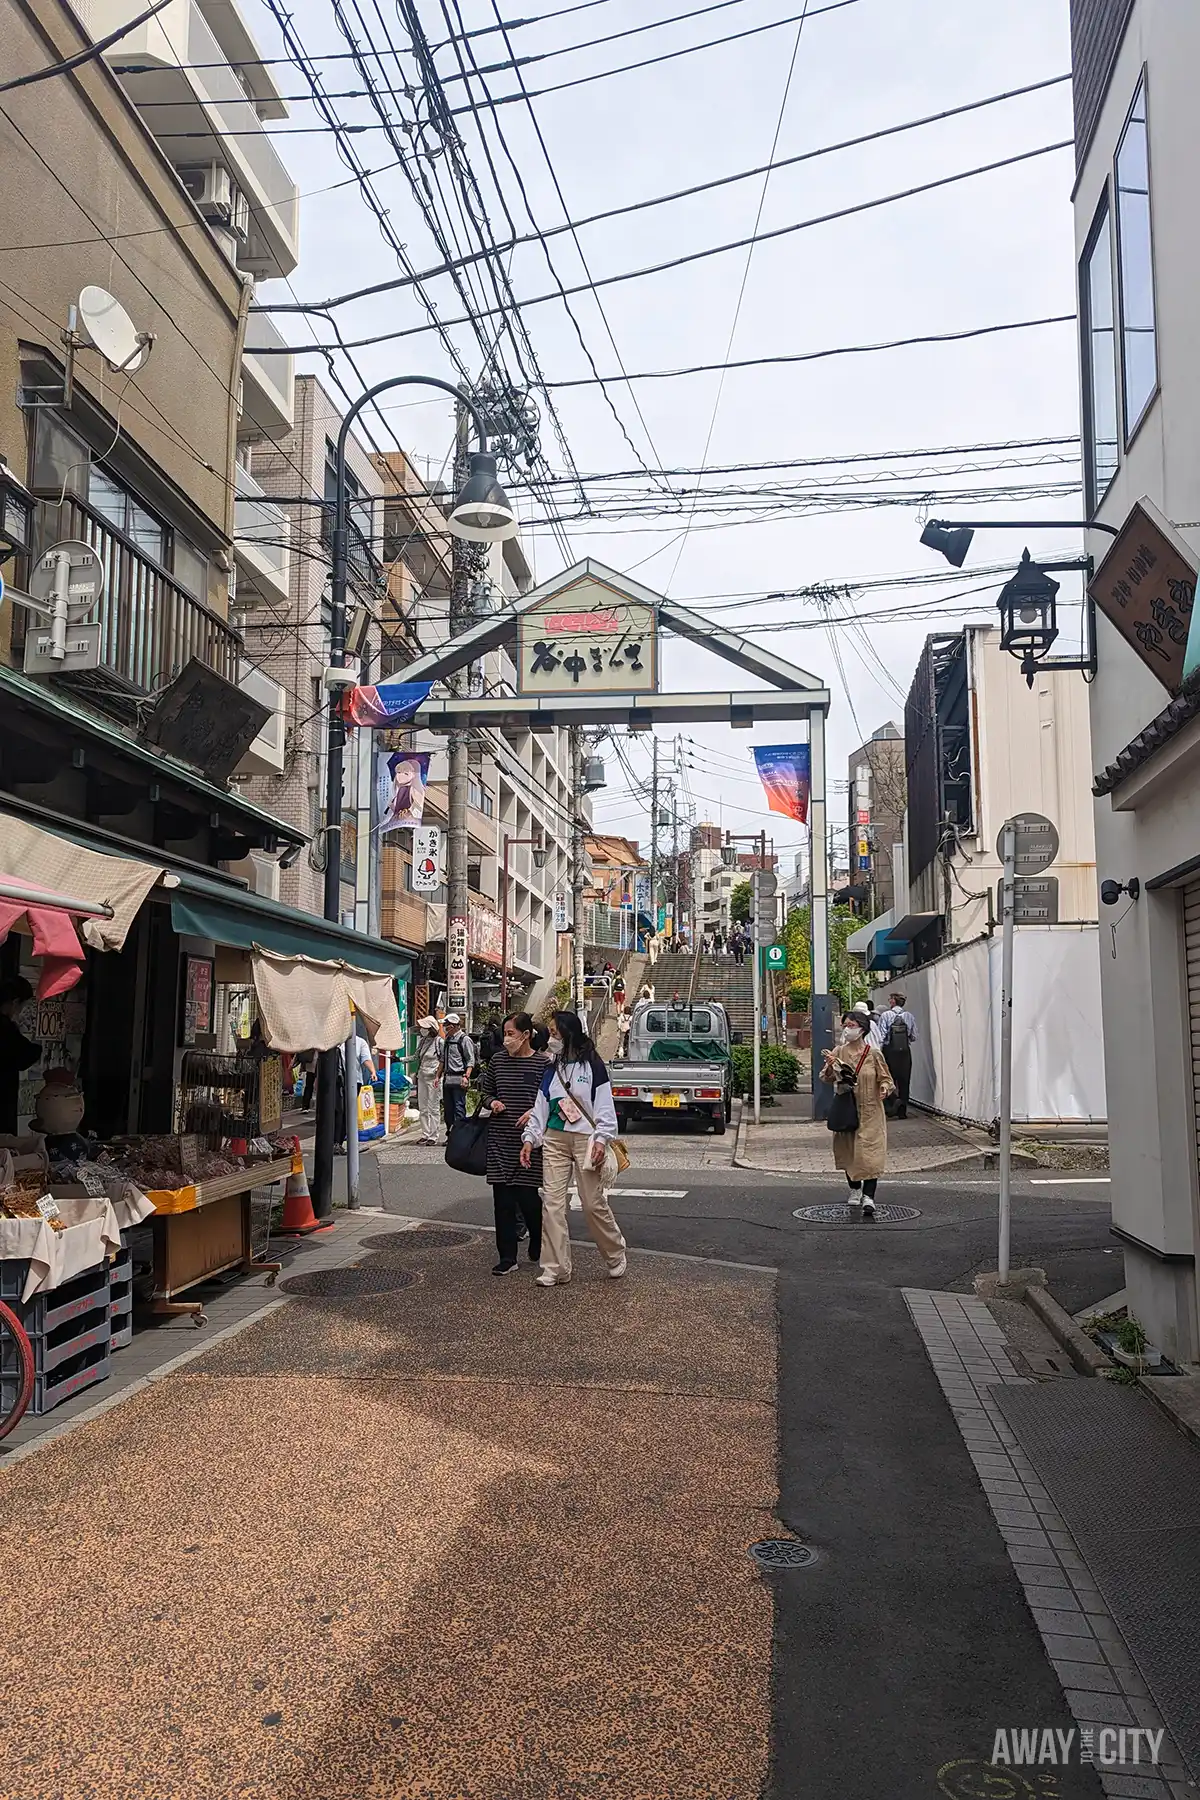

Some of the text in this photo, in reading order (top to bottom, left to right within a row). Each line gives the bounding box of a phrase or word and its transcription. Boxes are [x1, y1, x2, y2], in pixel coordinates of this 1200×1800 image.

[530, 626, 651, 683] 谷中ぎんざ
[429, 830, 437, 857] かき氷
